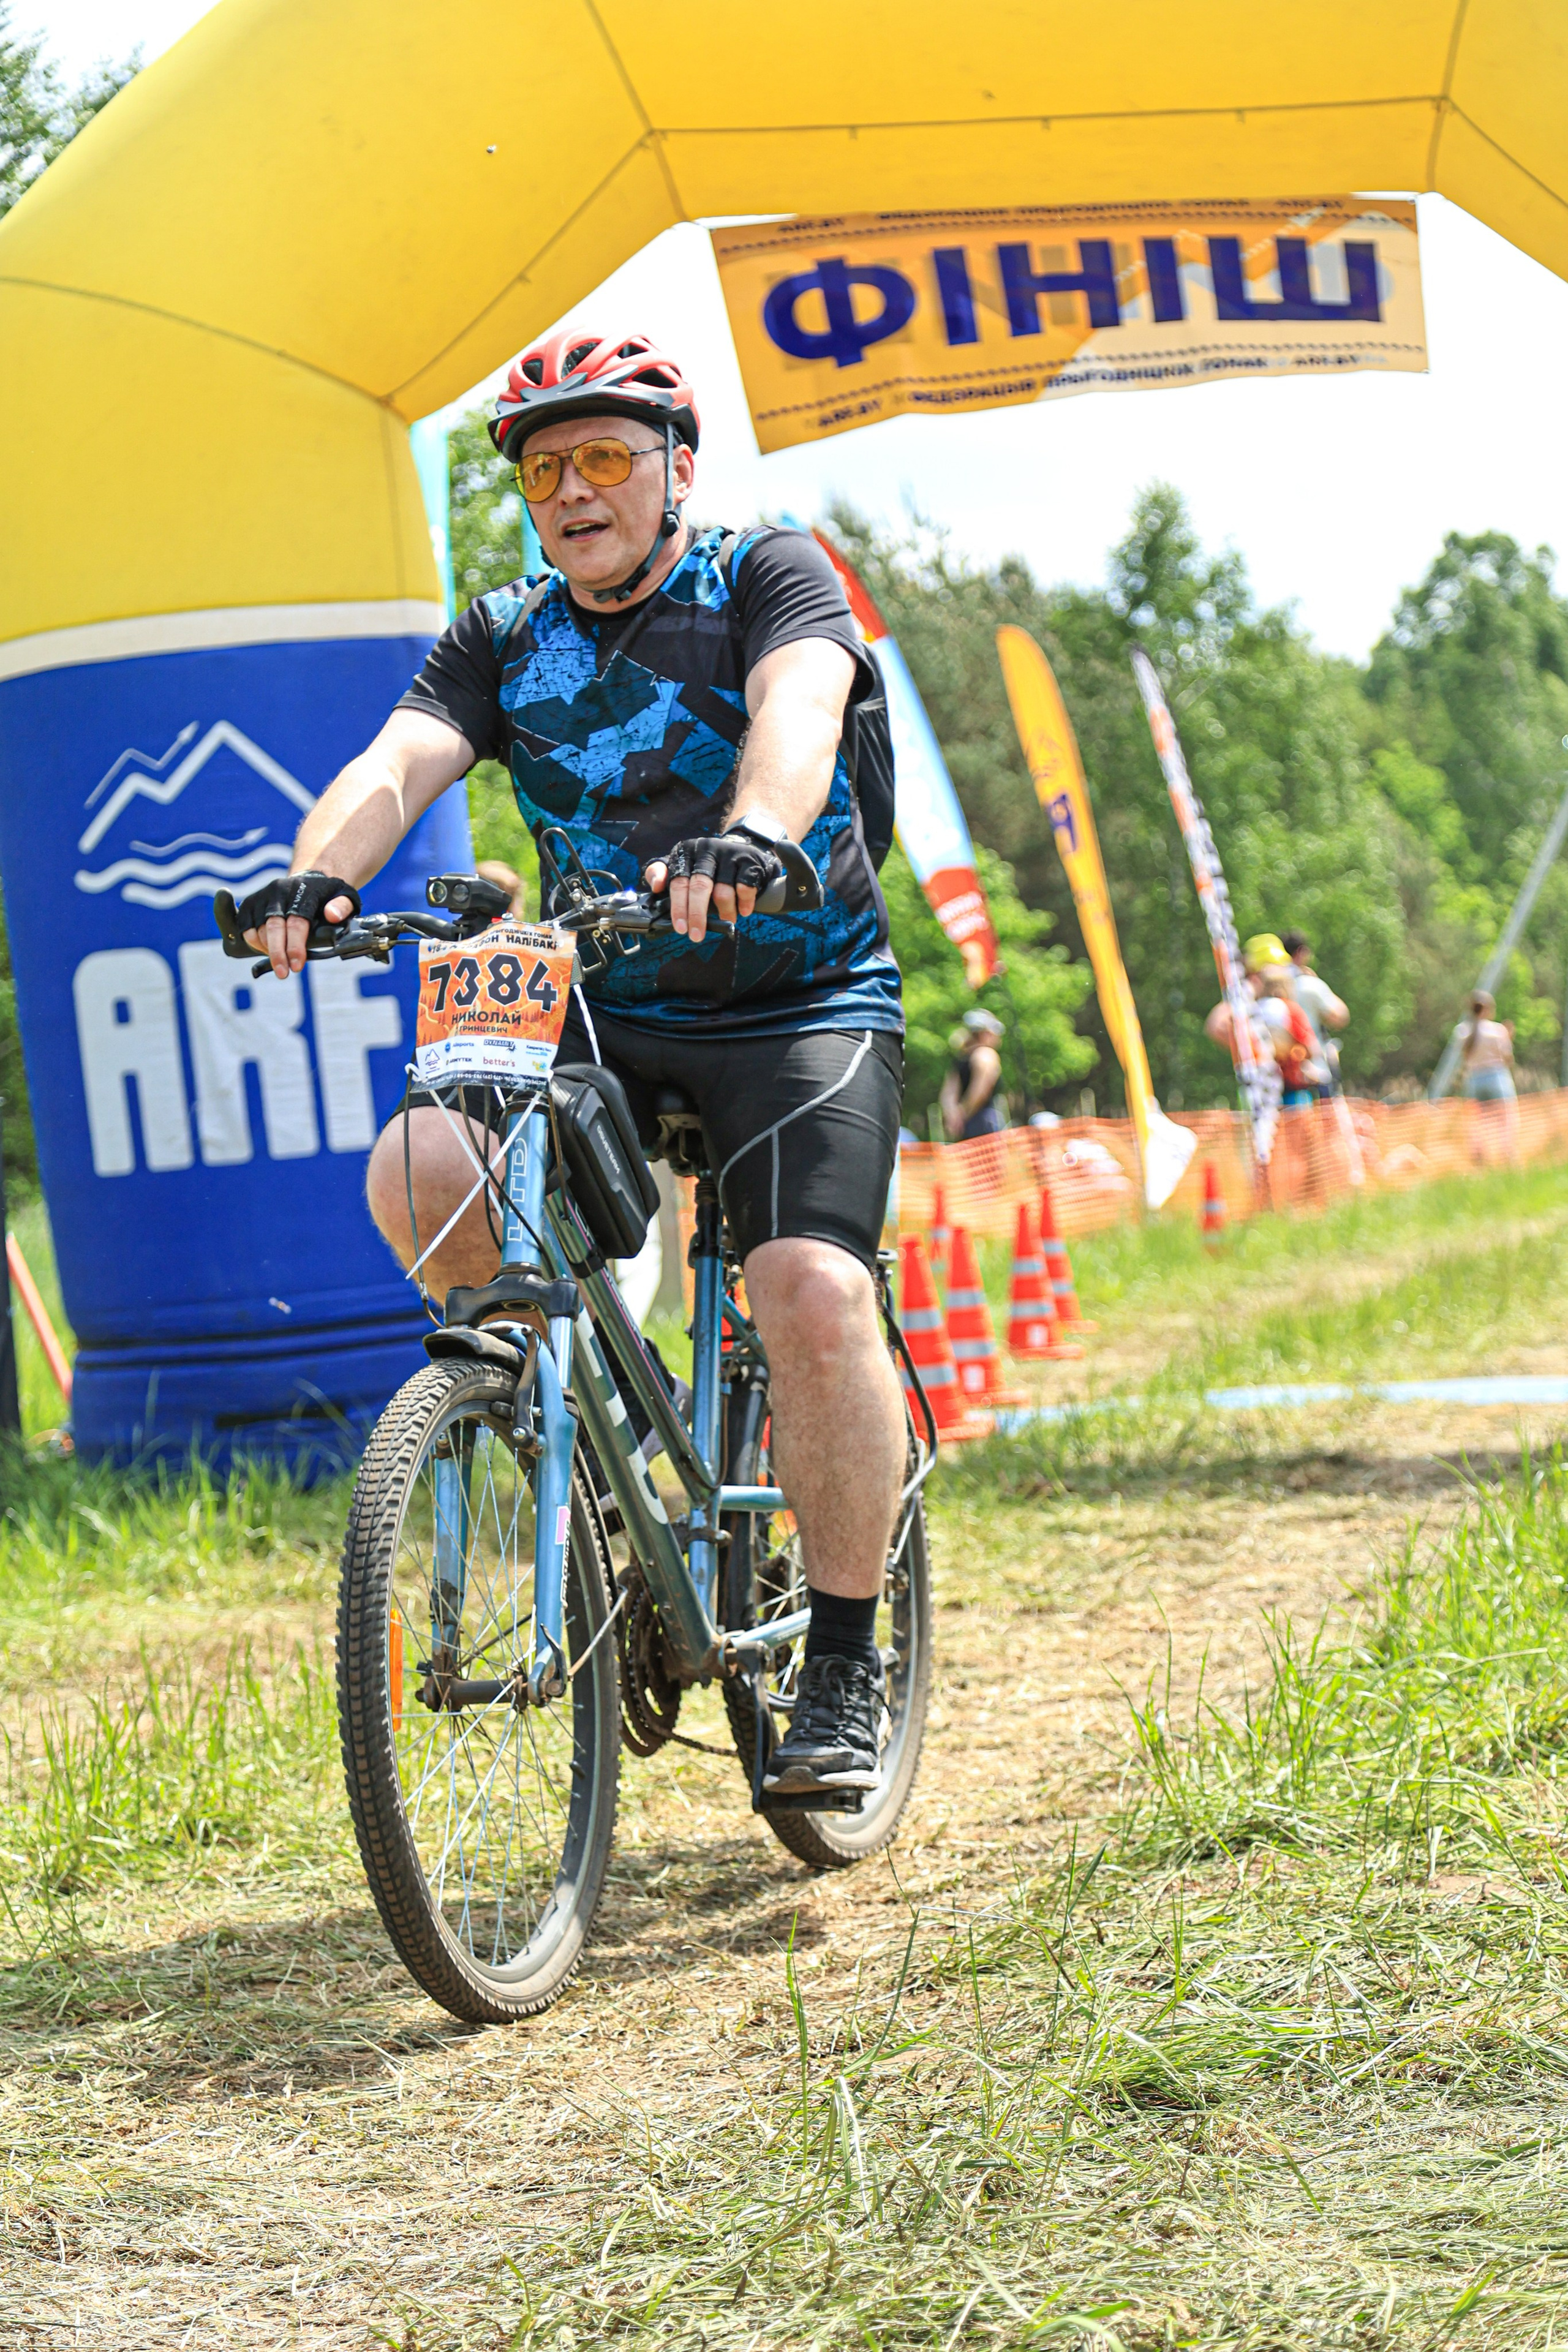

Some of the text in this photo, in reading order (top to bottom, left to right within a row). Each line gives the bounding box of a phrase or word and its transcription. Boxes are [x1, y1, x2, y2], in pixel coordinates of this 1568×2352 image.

[763, 235, 1382, 369] ФІНІШ
[428, 952, 558, 1012] 7384
[451, 1010, 521, 1025] НИКОЛАЙ
[74, 941, 403, 1178] ARF
[483, 1057, 516, 1068] better's
[507, 1137, 529, 1242] LTD
